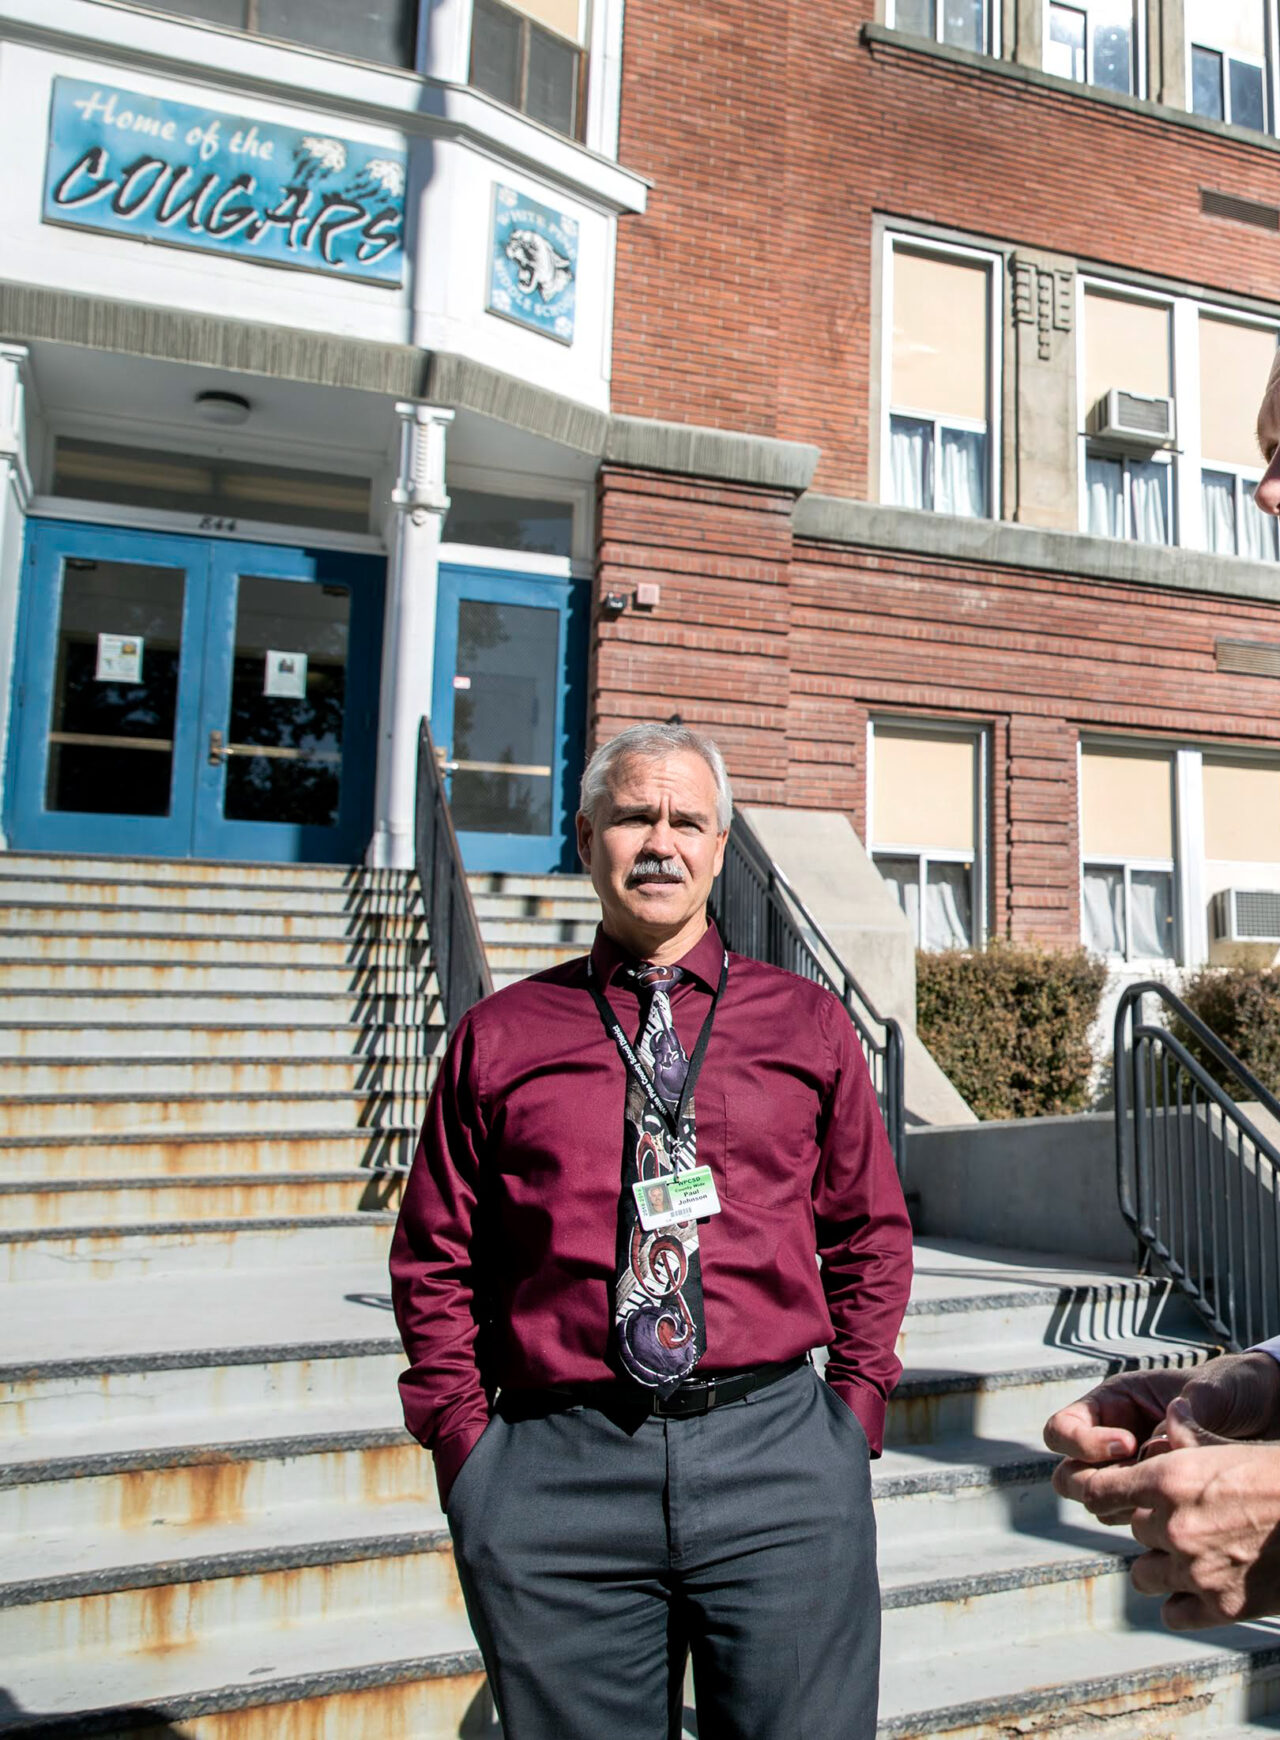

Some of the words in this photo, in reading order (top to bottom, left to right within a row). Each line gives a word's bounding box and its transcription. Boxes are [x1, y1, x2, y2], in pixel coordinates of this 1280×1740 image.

[74, 91, 177, 141] Home
[185, 120, 221, 161] of
[229, 126, 274, 161] the
[53, 147, 403, 269] COUGARS
[622, 1043, 637, 1065] School
[634, 1062, 649, 1086] County
[645, 1083, 657, 1099] Pine
[678, 1194, 708, 1206] Johnson
[684, 1189, 700, 1197] Paul
